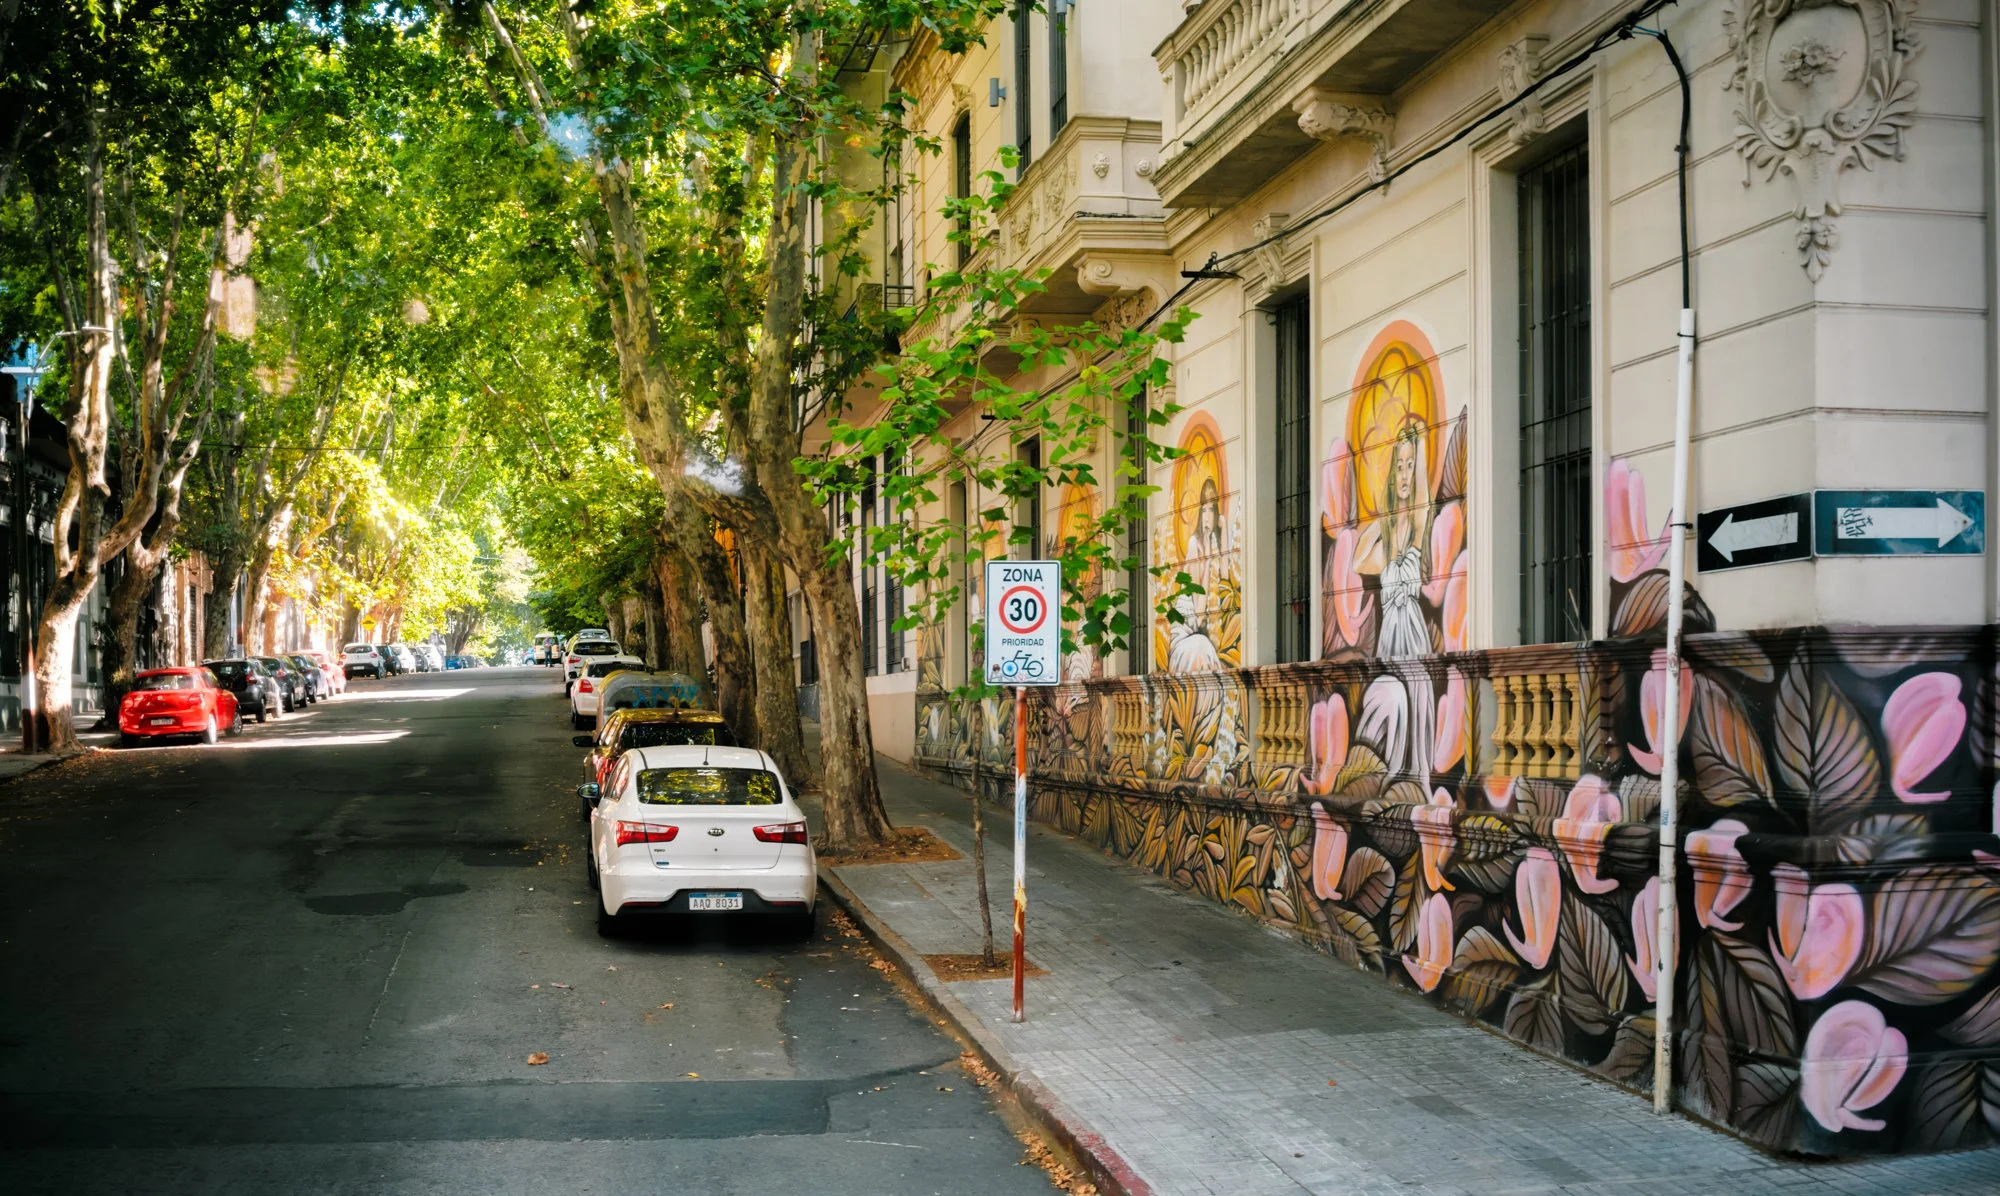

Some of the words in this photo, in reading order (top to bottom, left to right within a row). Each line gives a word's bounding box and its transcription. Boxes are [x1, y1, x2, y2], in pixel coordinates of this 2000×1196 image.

[1002, 568, 1043, 582] ZONA
[1009, 598, 1038, 622] 30
[1001, 638, 1045, 647] PRIORIDAD
[715, 898, 740, 908] 8031
